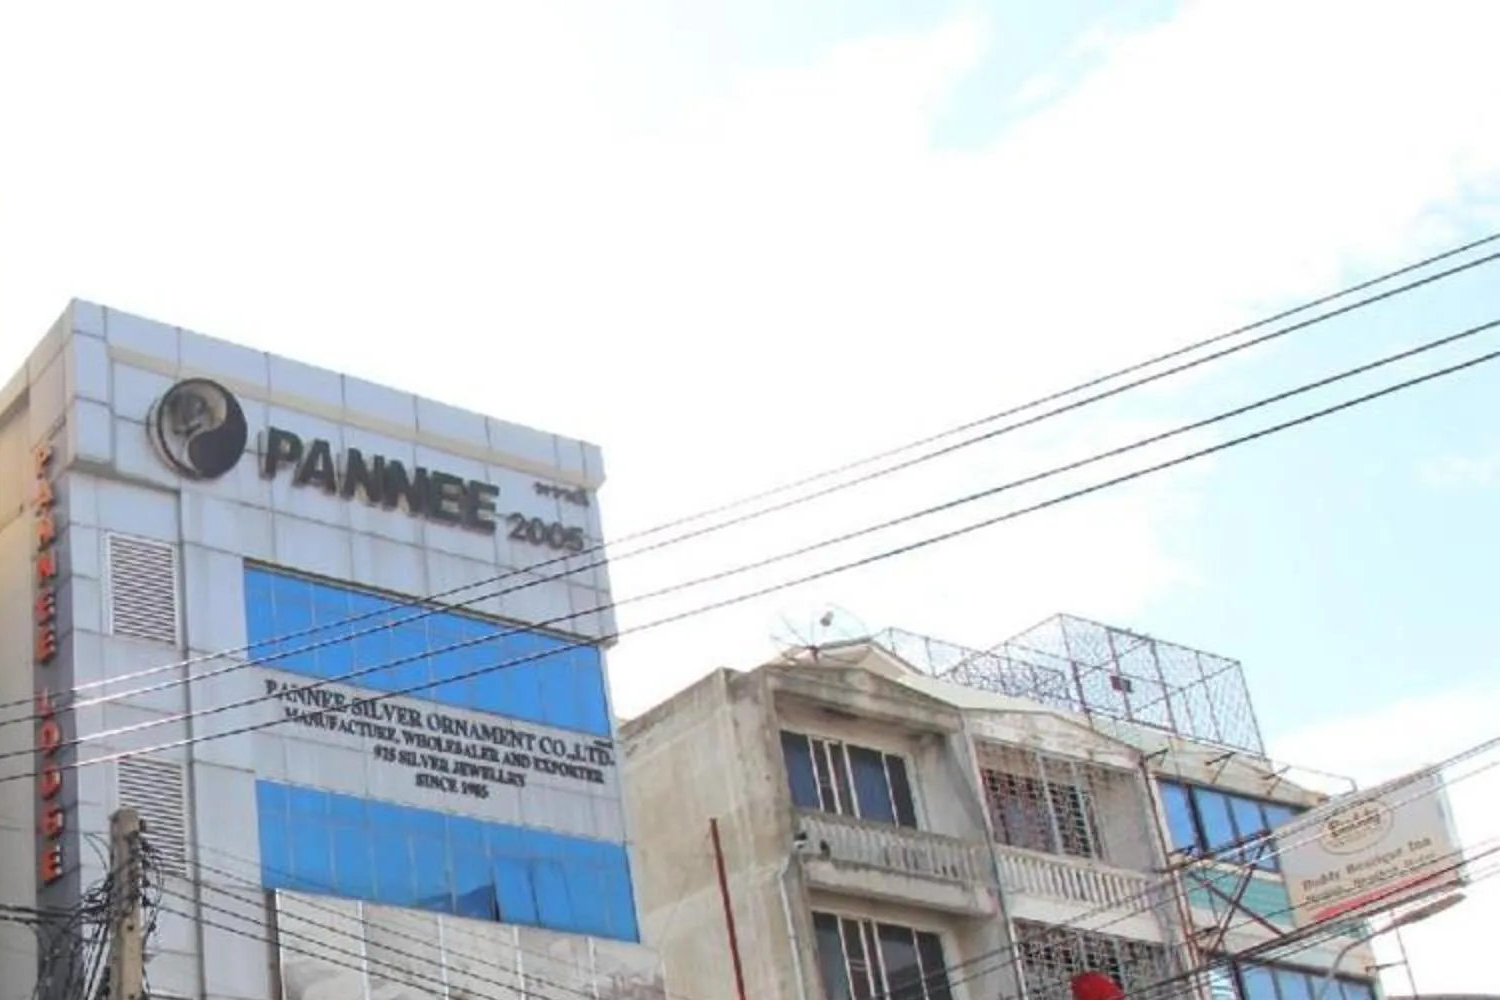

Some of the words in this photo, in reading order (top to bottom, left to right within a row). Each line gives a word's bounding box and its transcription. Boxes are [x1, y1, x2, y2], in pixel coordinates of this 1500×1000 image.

[258, 426, 500, 536] PANNEE
[31, 442, 57, 664] PANNEE
[508, 511, 586, 552] 2005
[265, 678, 346, 713] PANNEE
[352, 697, 423, 728] SILVER
[426, 713, 537, 755] ORNAMENT
[37, 687, 65, 885] LODGE
[398, 749, 450, 772] SILVER
[415, 772, 459, 794] SINCE
[502, 750, 532, 770] AND
[533, 757, 605, 785] EXPORTER
